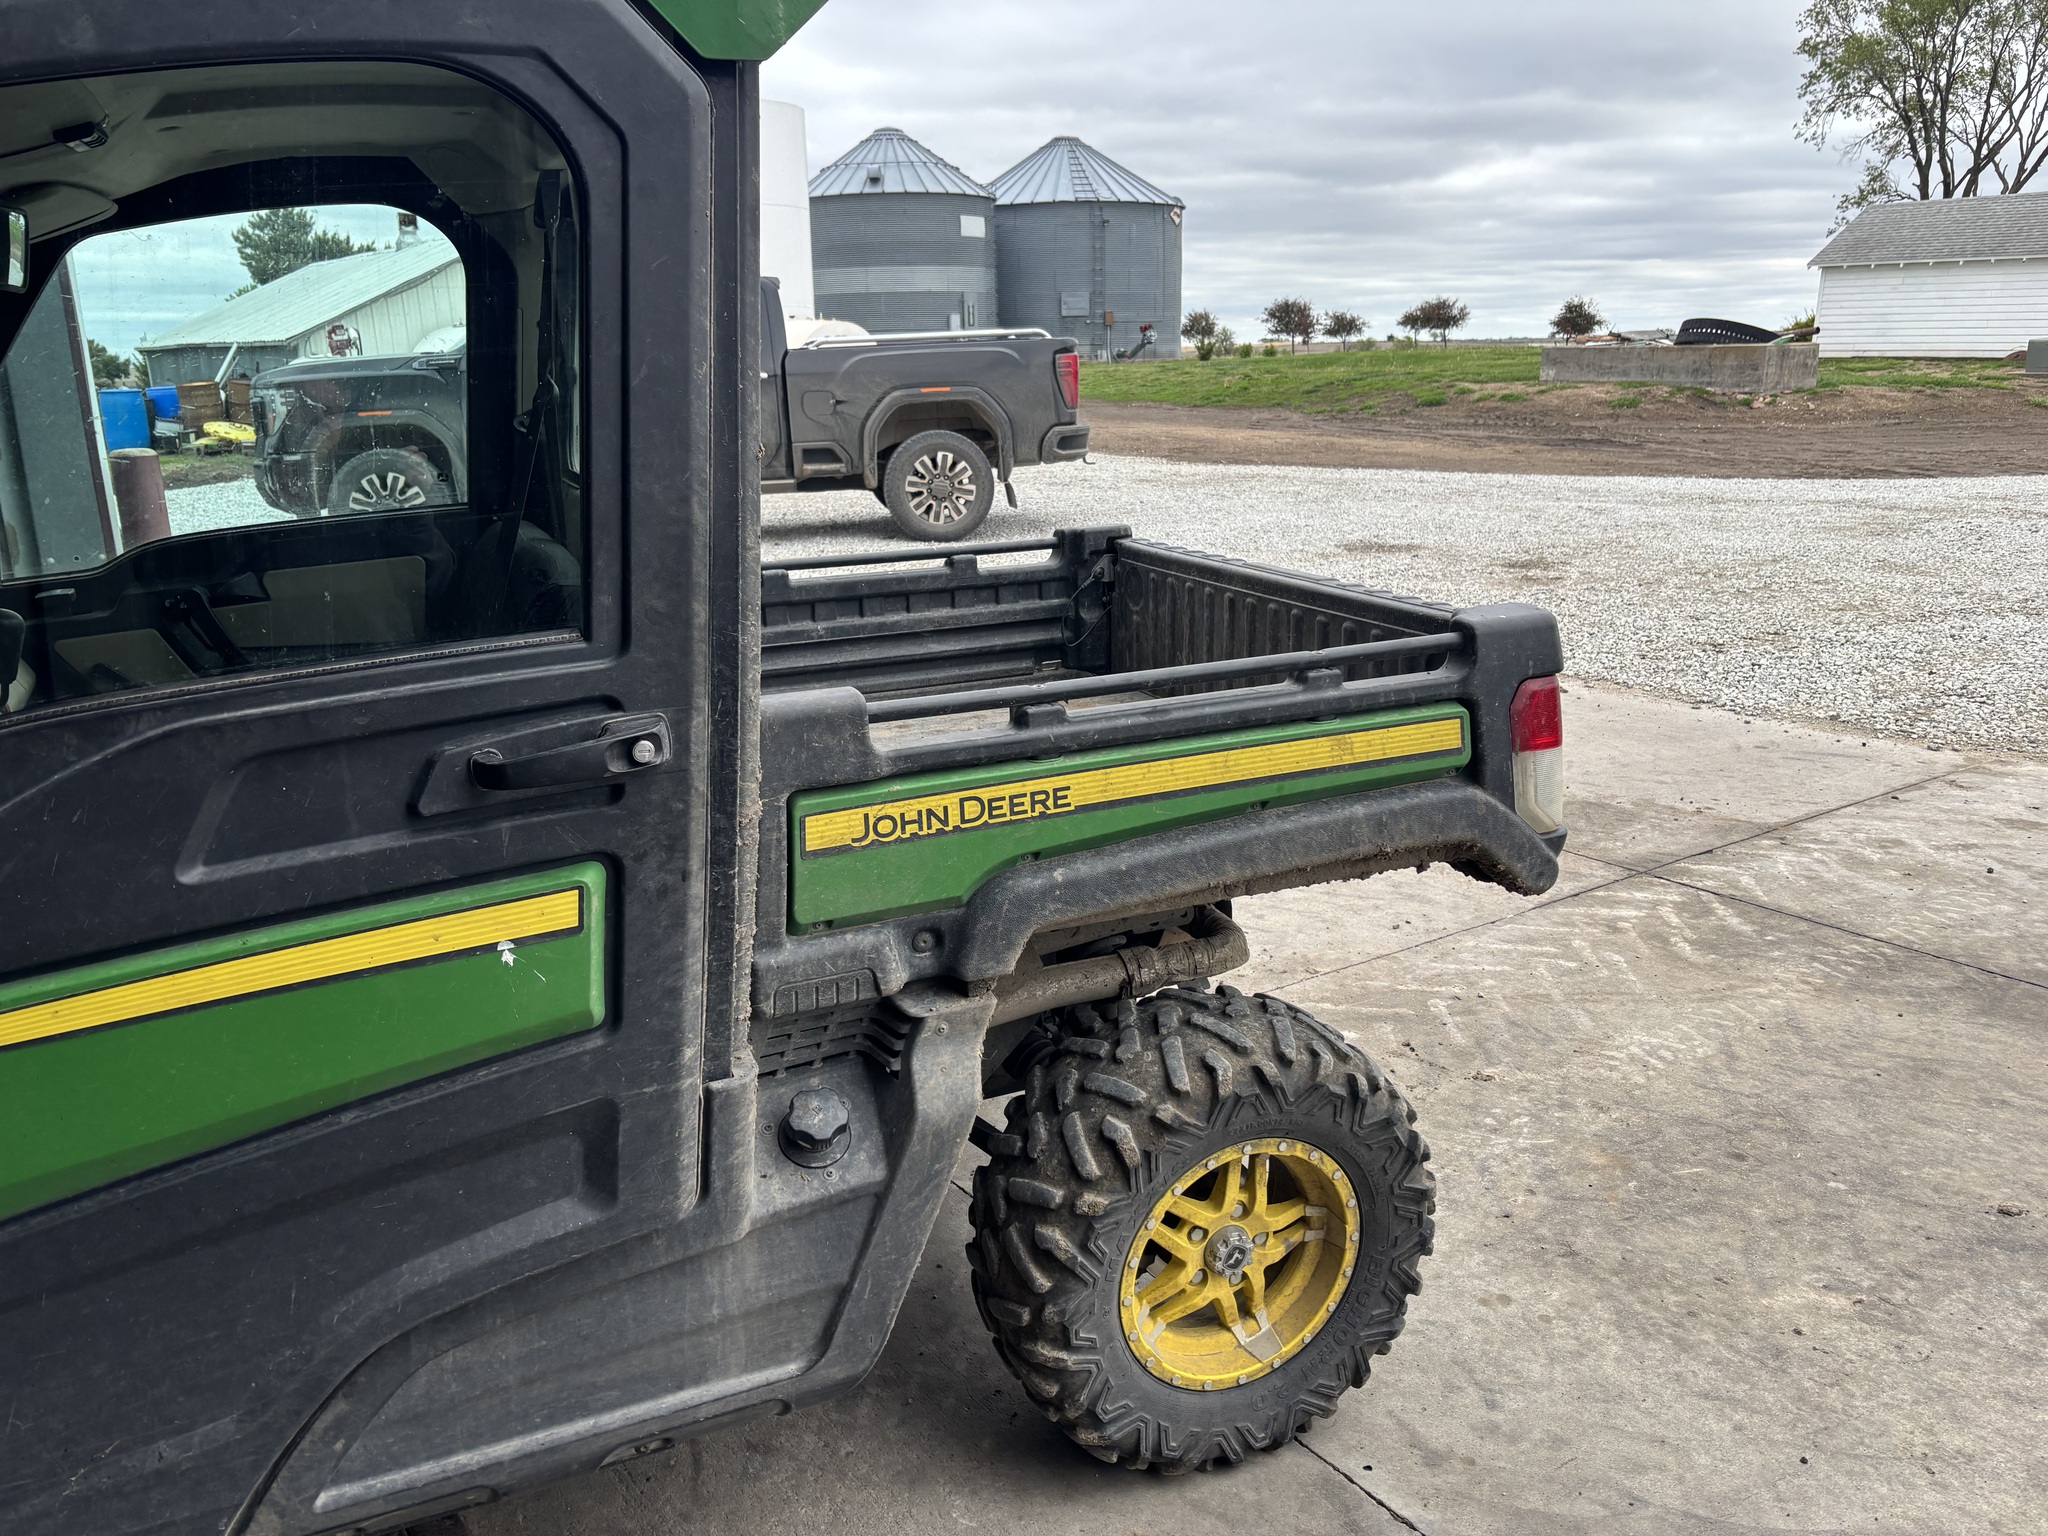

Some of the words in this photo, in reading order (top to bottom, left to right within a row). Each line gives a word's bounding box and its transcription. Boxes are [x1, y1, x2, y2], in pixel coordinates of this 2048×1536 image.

[851, 806, 949, 843] JOHN
[959, 786, 1071, 827] DEERE
[1301, 1254, 1385, 1382] BIGHORN
[1251, 1381, 1290, 1412] 2.0
